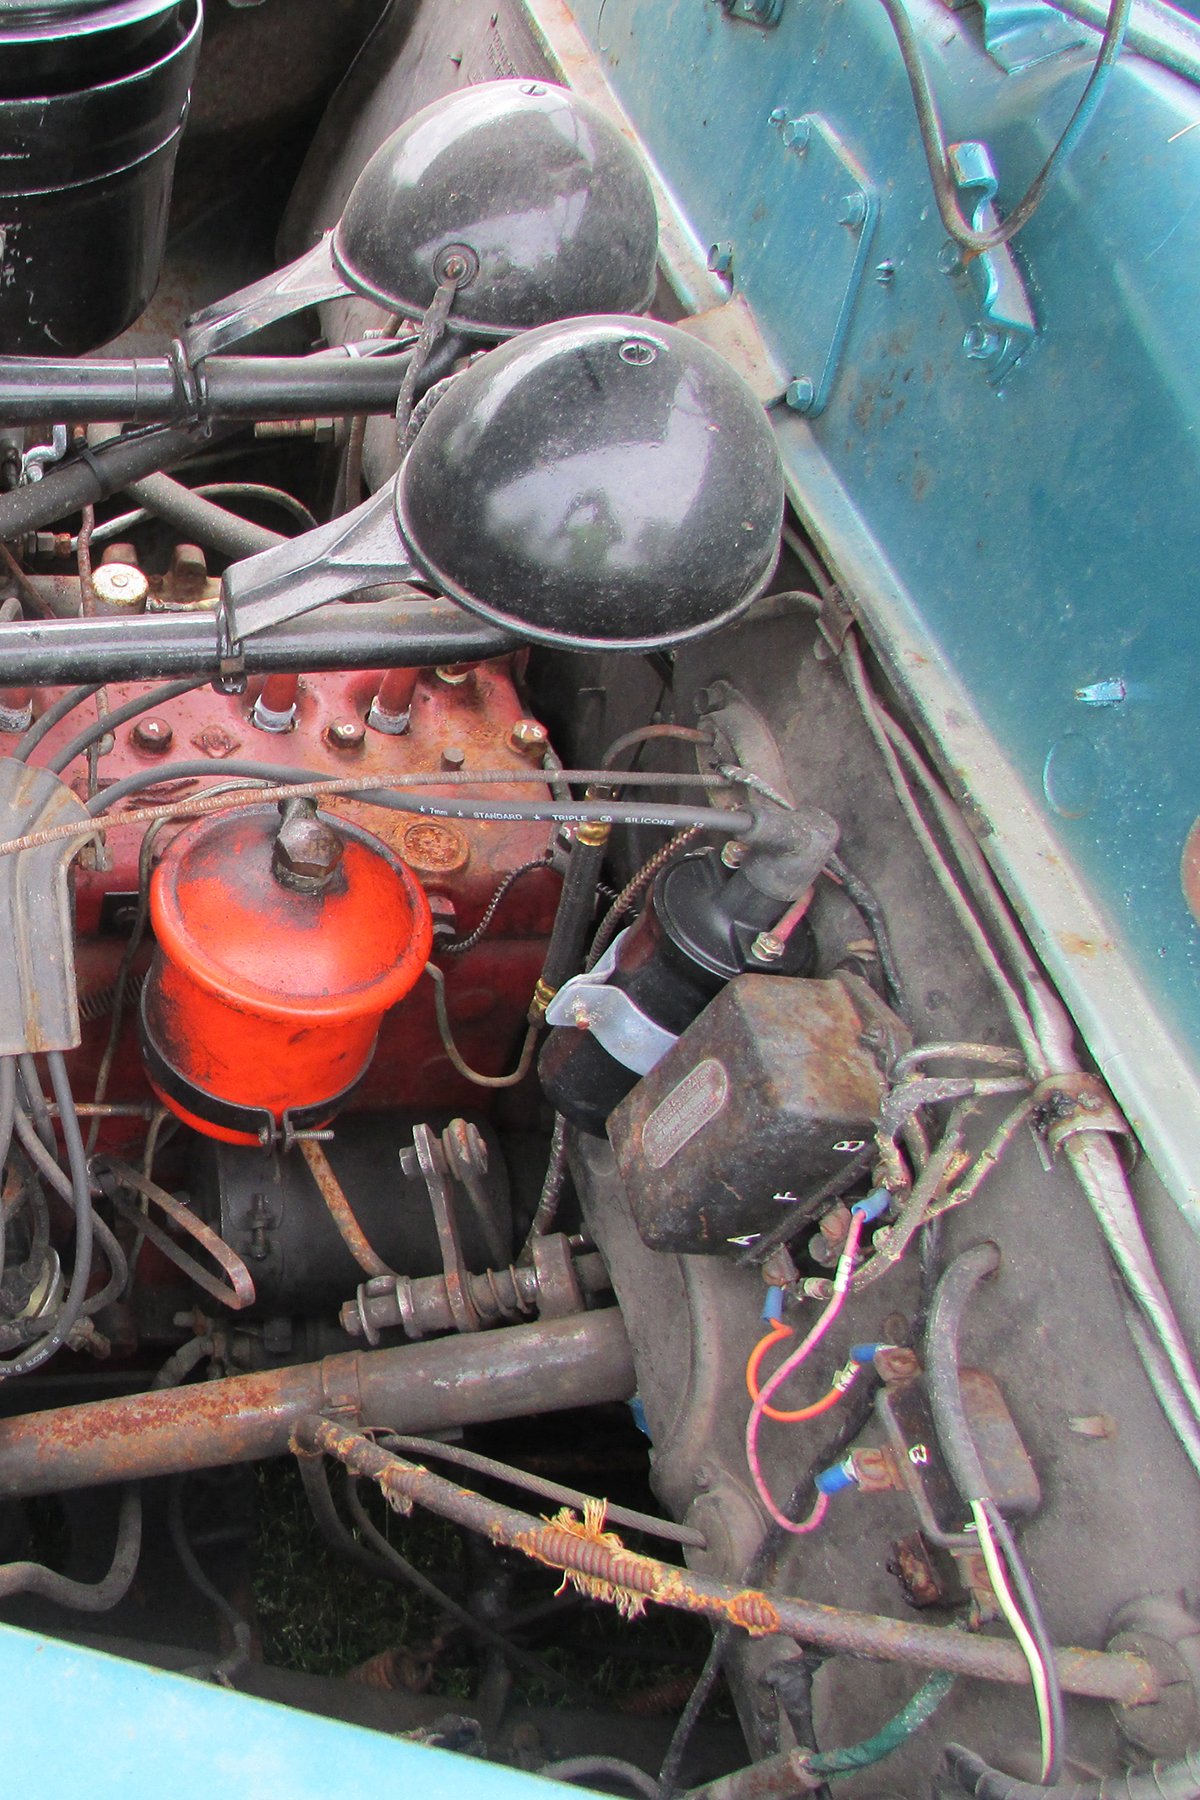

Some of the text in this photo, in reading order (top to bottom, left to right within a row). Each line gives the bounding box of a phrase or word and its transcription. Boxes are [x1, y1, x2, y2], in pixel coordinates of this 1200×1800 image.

[337, 723, 355, 736] 10
[429, 807, 448, 816] 7mm
[473, 811, 522, 820] STANDARD
[552, 814, 588, 822] TRIPLE
[624, 817, 675, 826] SILICONE
